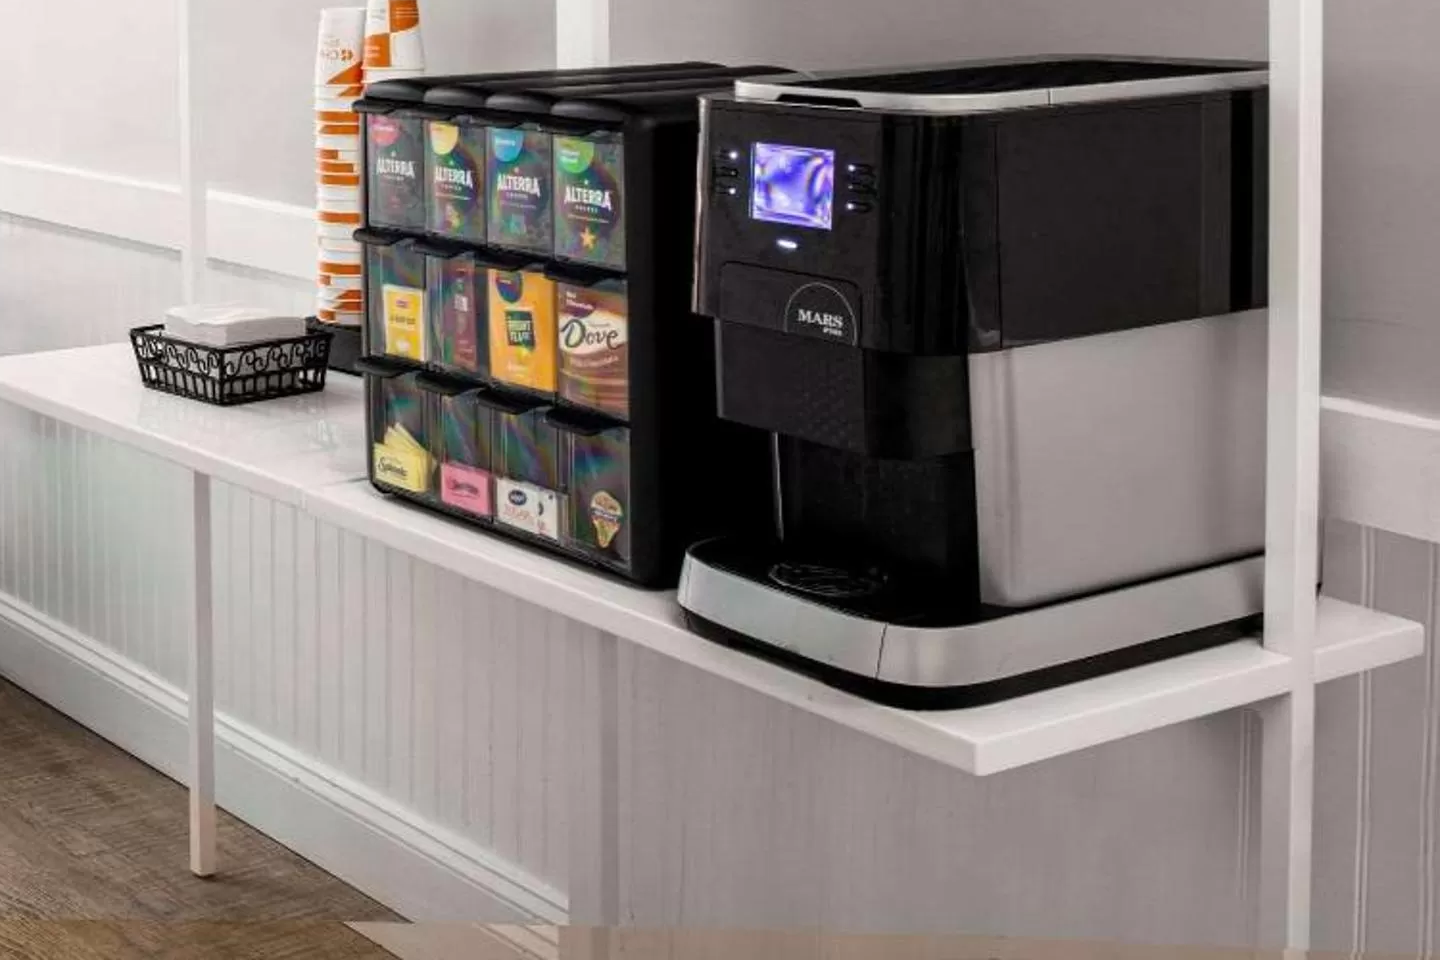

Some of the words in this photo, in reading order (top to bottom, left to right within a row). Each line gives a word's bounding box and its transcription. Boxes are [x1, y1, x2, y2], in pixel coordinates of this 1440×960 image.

[376, 156, 415, 179] ALTERRA
[434, 165, 473, 189] ALTERRA
[497, 173, 541, 198] ALTERRA
[563, 185, 612, 211] ALTERRA
[798, 309, 843, 328] MARS
